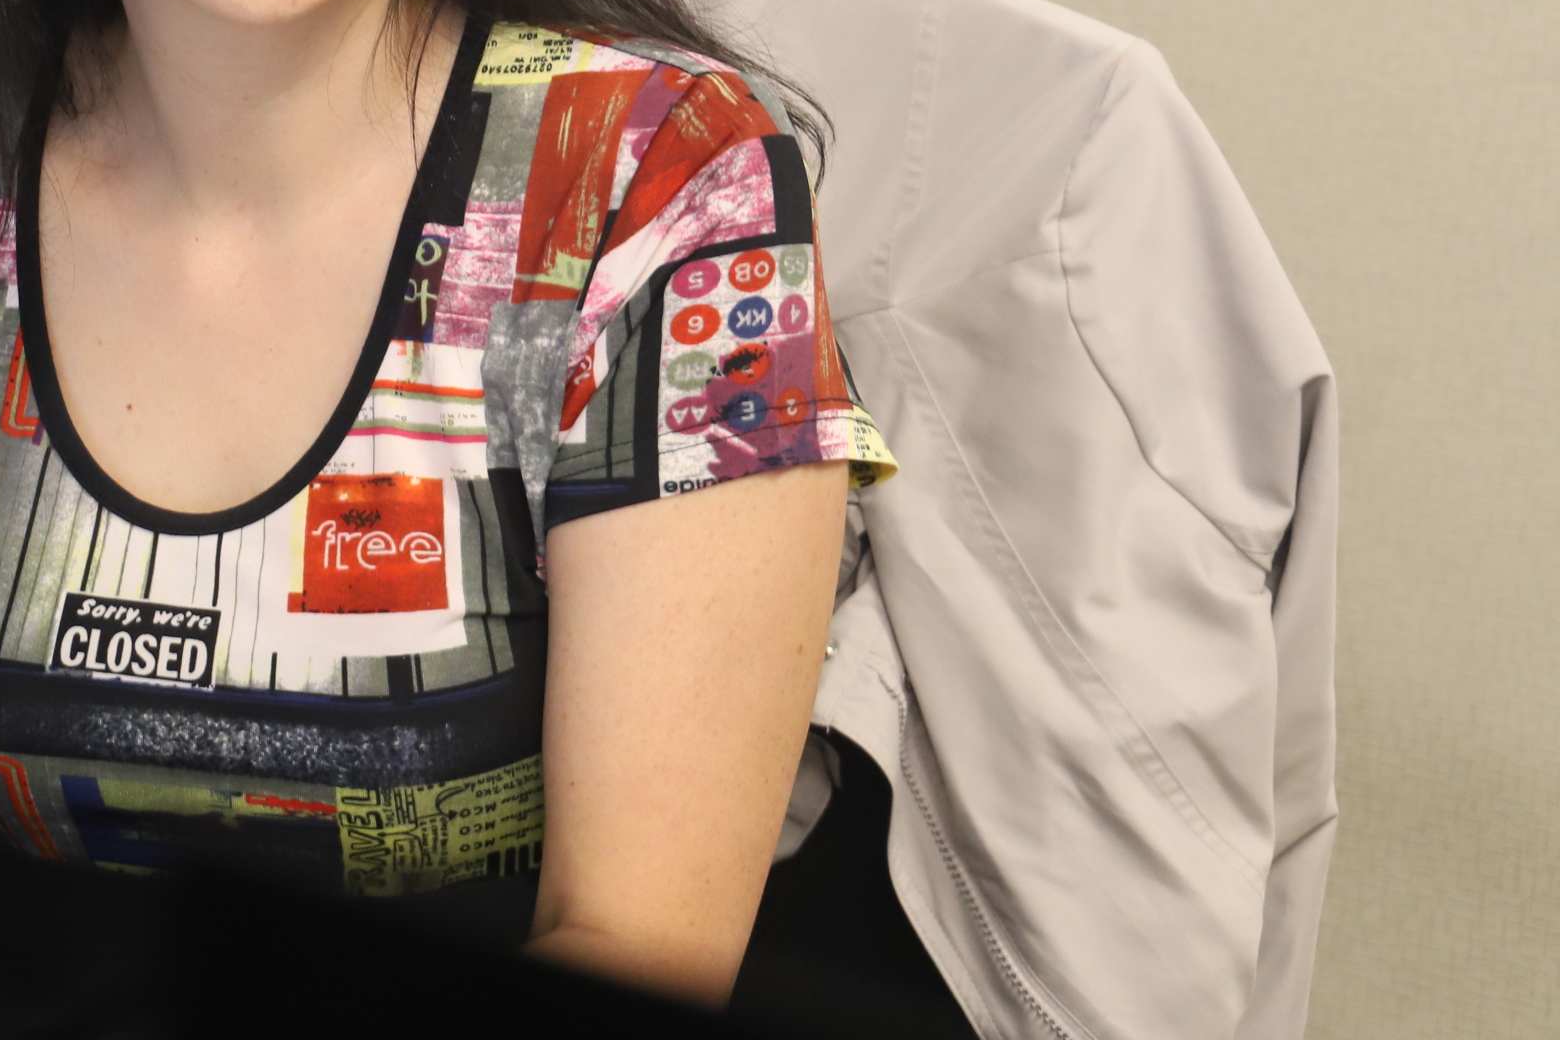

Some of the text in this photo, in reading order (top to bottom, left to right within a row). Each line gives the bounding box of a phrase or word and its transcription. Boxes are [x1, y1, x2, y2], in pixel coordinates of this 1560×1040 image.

[687, 270, 705, 291] 5
[687, 303, 802, 334] 4 KK 6
[670, 398, 799, 425] 2 E AA
[311, 520, 443, 571] free
[152, 609, 213, 631] we're
[60, 625, 209, 682] CLOSED
[459, 802, 497, 818] MCO
[459, 820, 496, 835] MCO
[459, 837, 496, 853] MCO
